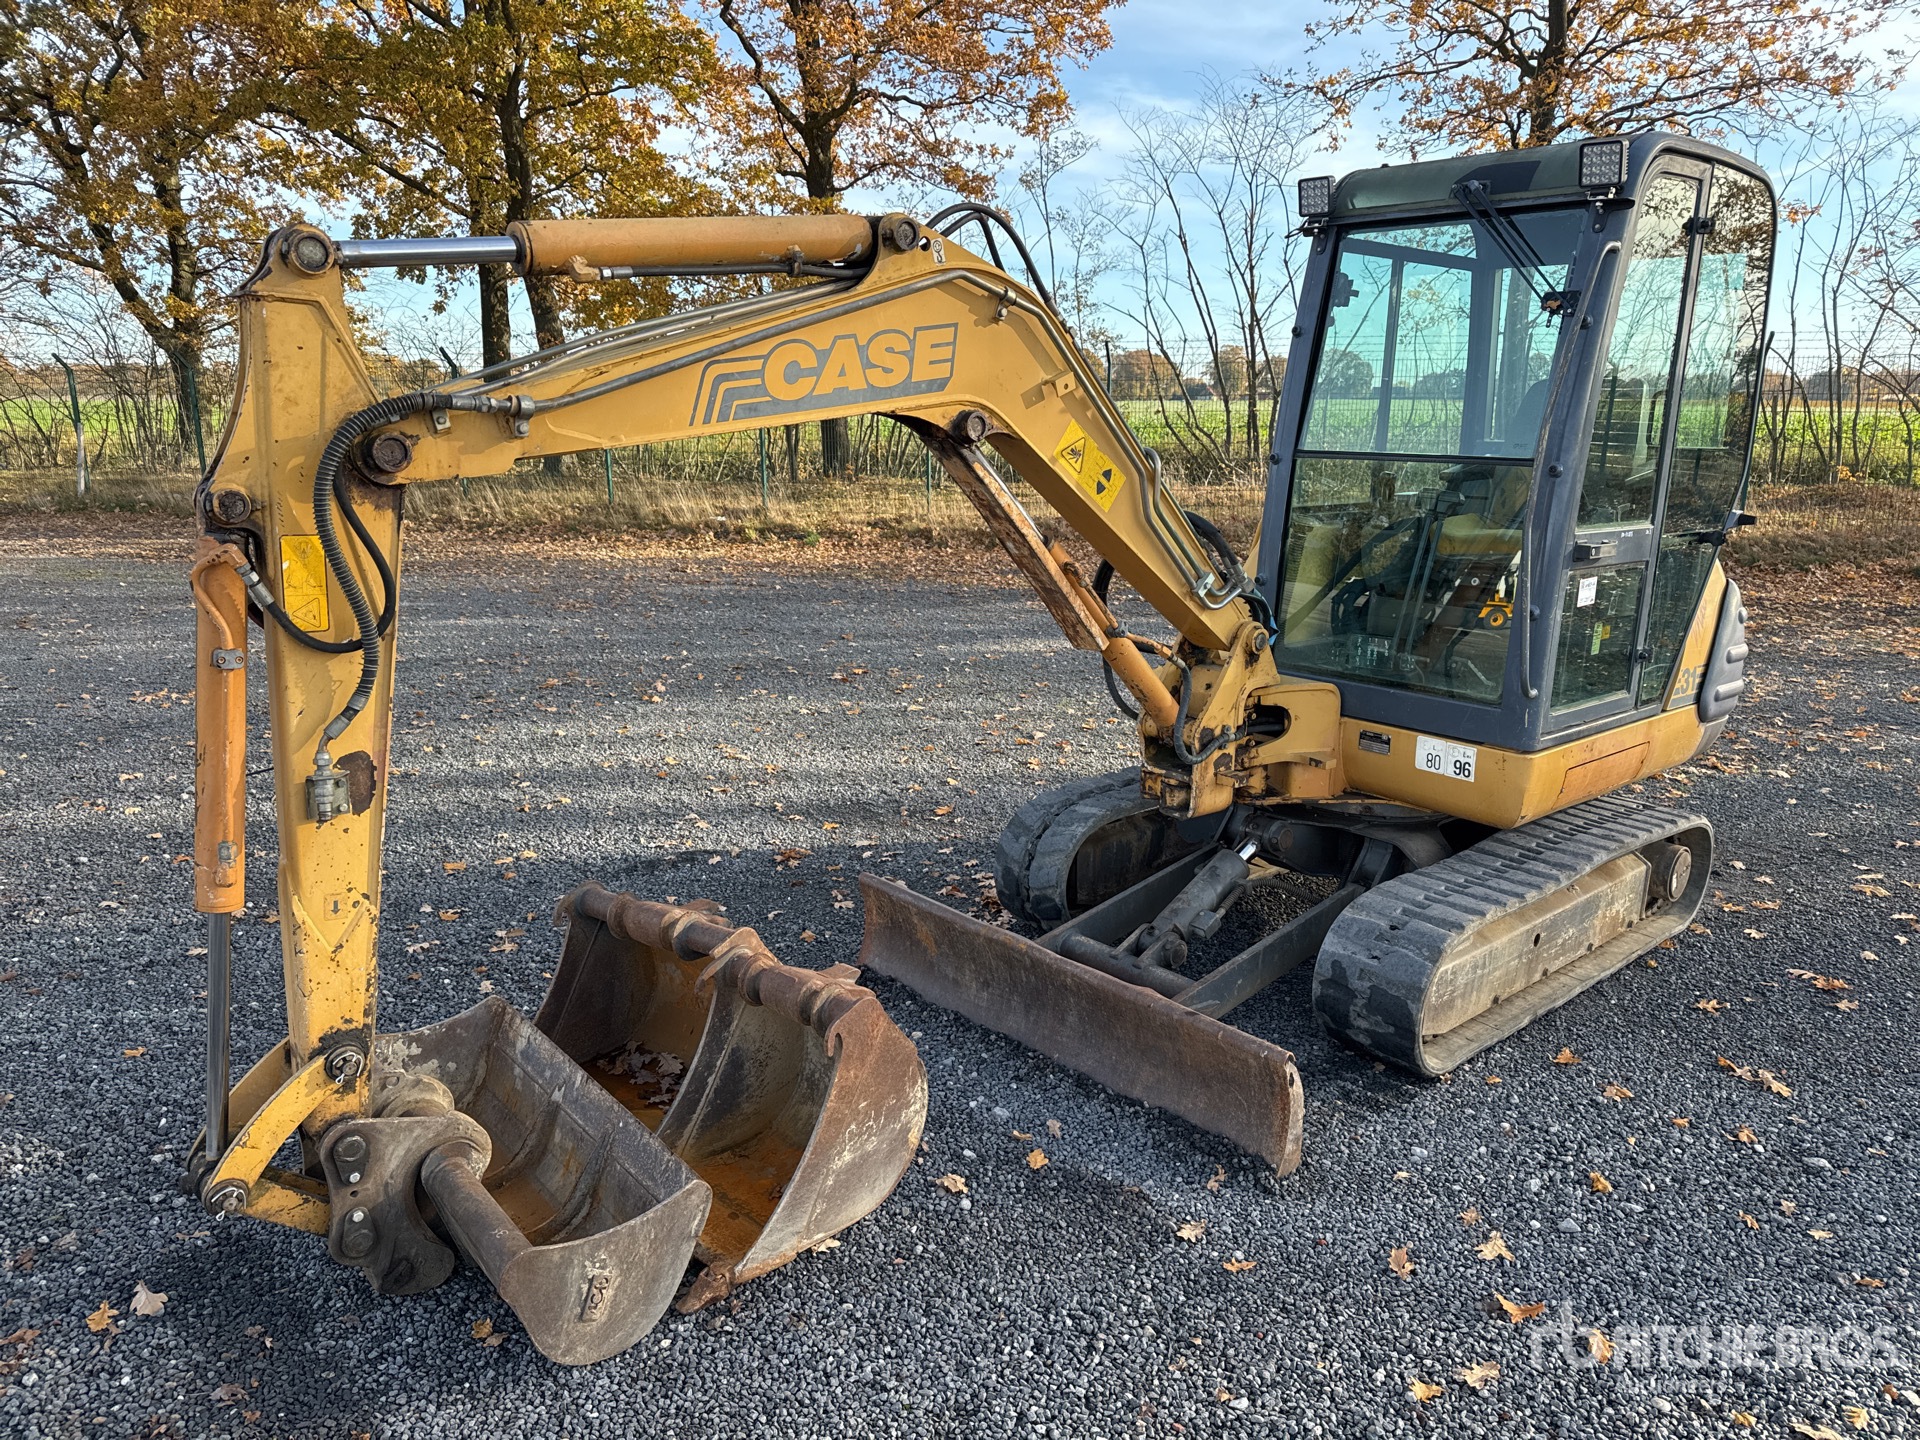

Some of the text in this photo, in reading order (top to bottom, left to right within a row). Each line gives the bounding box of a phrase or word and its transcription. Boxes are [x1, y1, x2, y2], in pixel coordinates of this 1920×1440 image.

[763, 326, 957, 401] CASE
[1426, 752, 1441, 771] 80
[1453, 759, 1472, 778] 96
